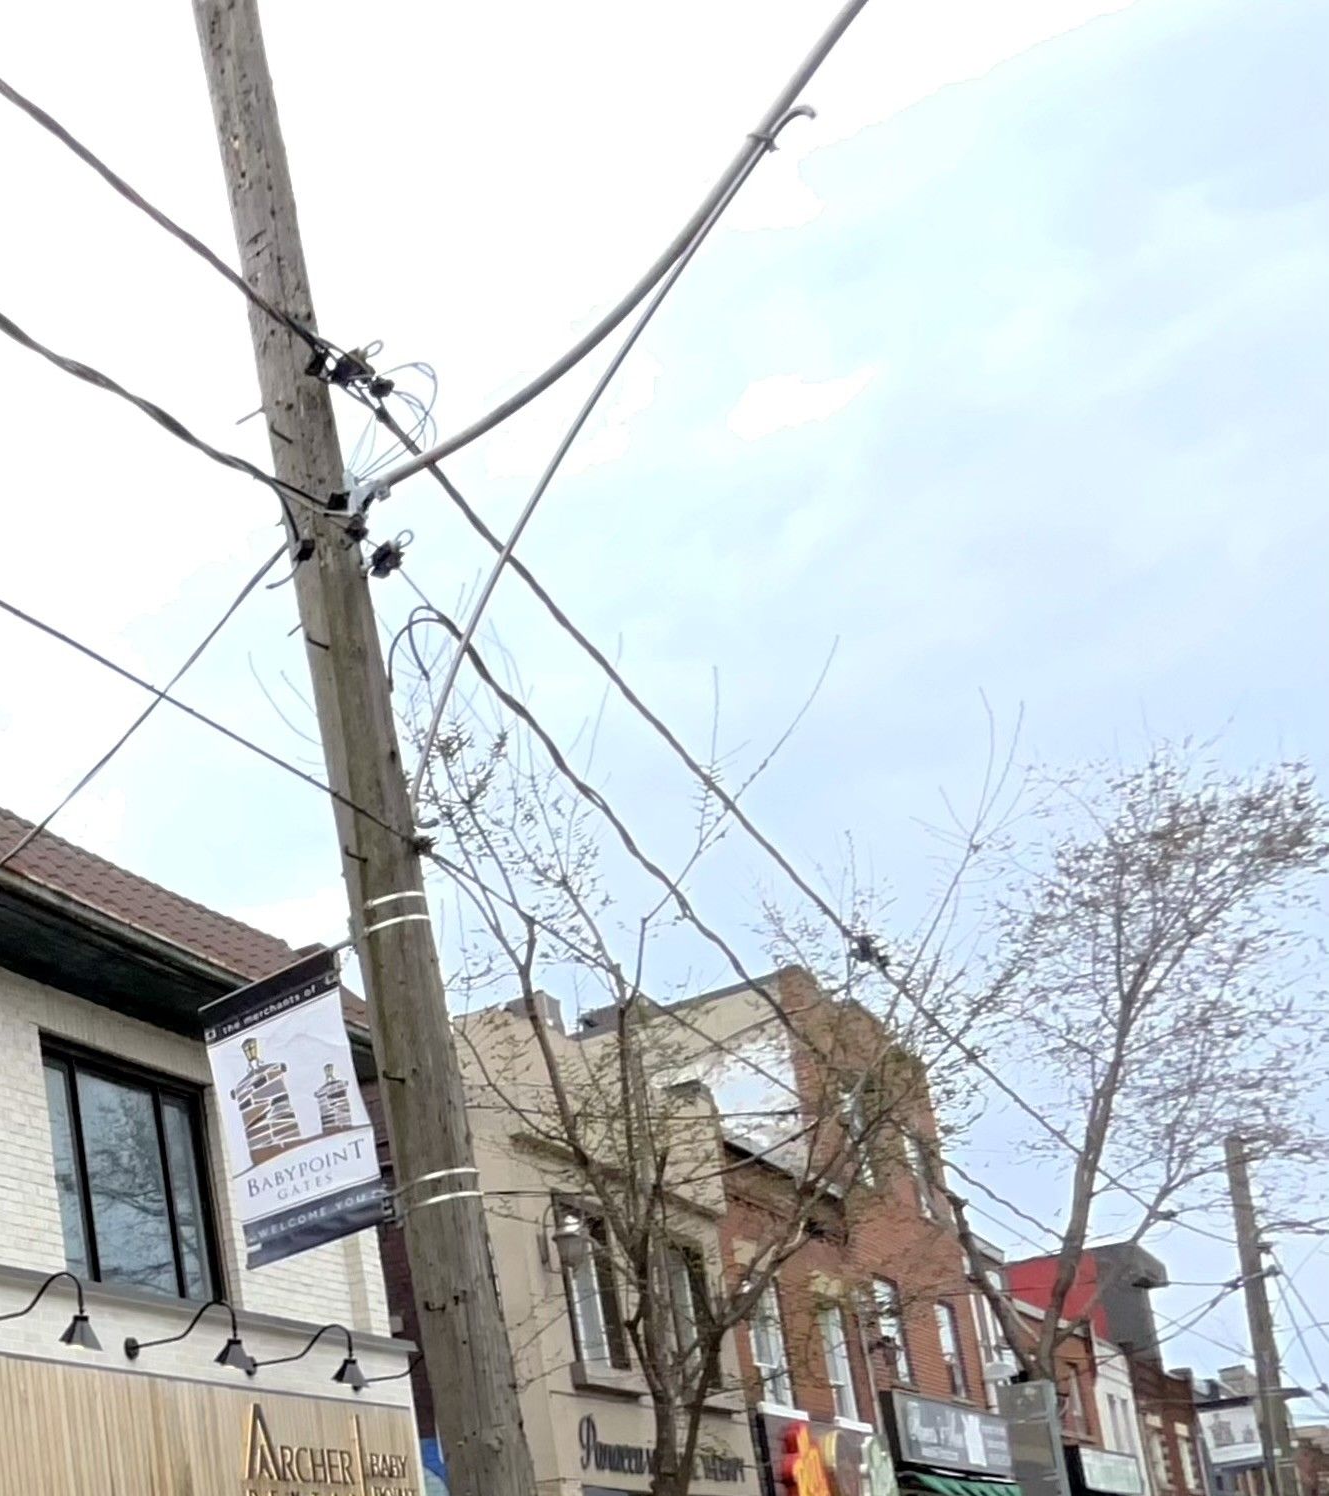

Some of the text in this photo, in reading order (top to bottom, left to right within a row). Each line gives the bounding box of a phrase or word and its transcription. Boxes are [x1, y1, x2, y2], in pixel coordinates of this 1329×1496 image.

[222, 984, 316, 1035] the merchants of
[247, 1138, 365, 1198] BABYPOINT
[277, 1173, 334, 1201] GATES
[257, 1193, 367, 1239] WELCOME YOU
[245, 1403, 355, 1485] ARCHER
[368, 1452, 408, 1479] BABY
